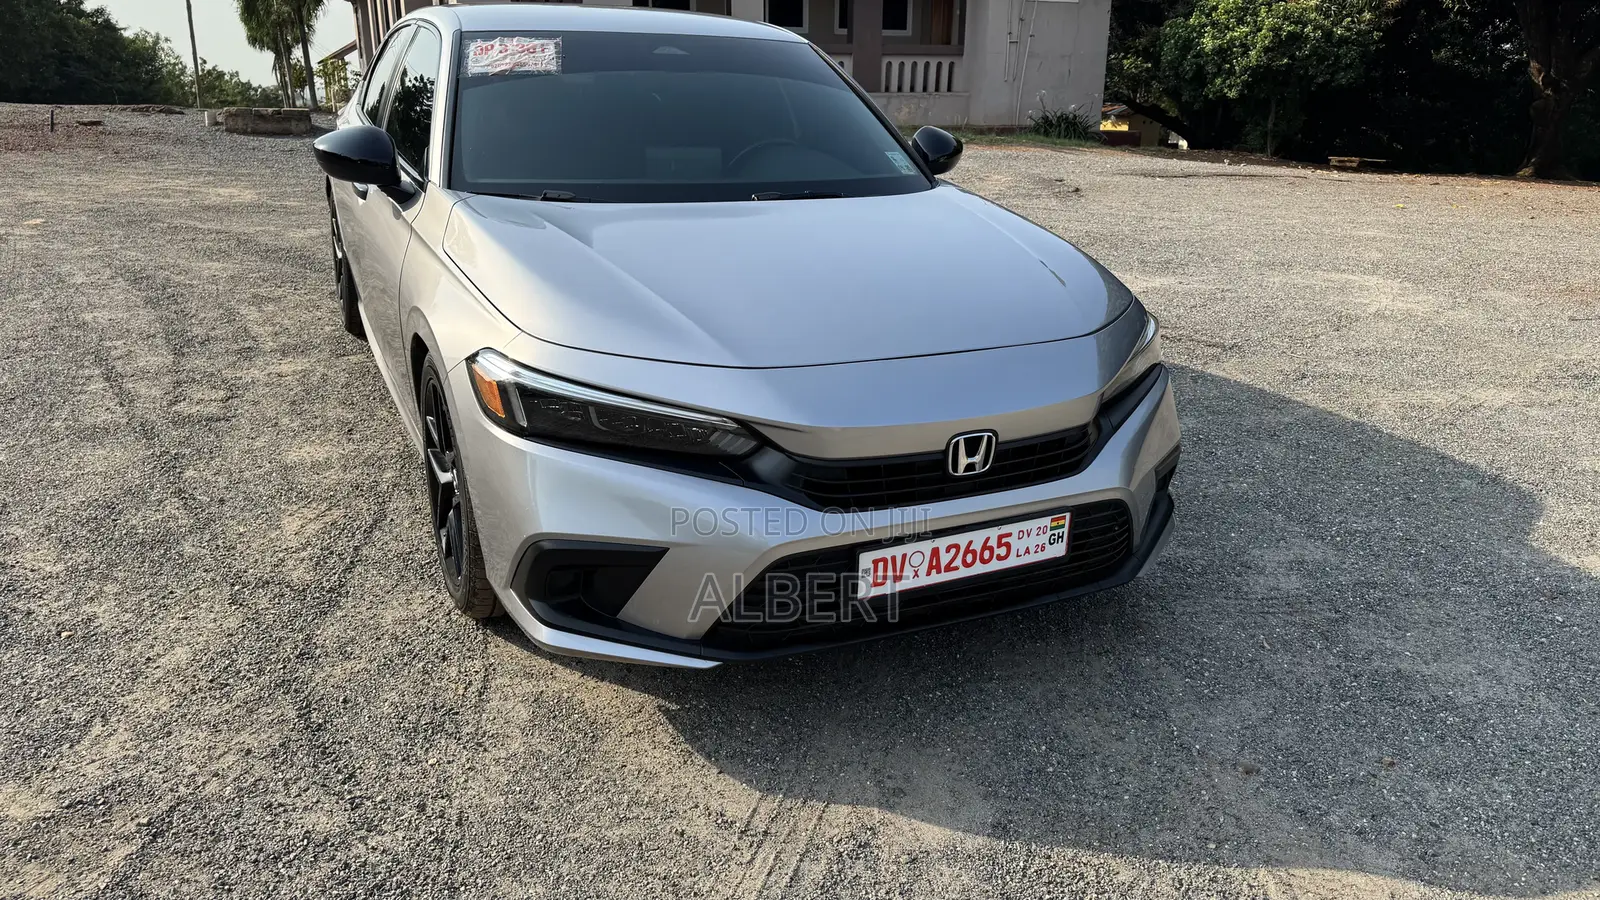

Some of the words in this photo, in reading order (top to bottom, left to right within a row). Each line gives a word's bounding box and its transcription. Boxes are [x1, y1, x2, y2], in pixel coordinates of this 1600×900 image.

[1017, 528, 1032, 540] DV
[1035, 525, 1048, 537] 20
[1048, 531, 1065, 546] GH
[1016, 546, 1031, 558] LA
[1034, 543, 1046, 554] 26
[871, 552, 907, 588] DV
[925, 532, 1012, 577] A2665
